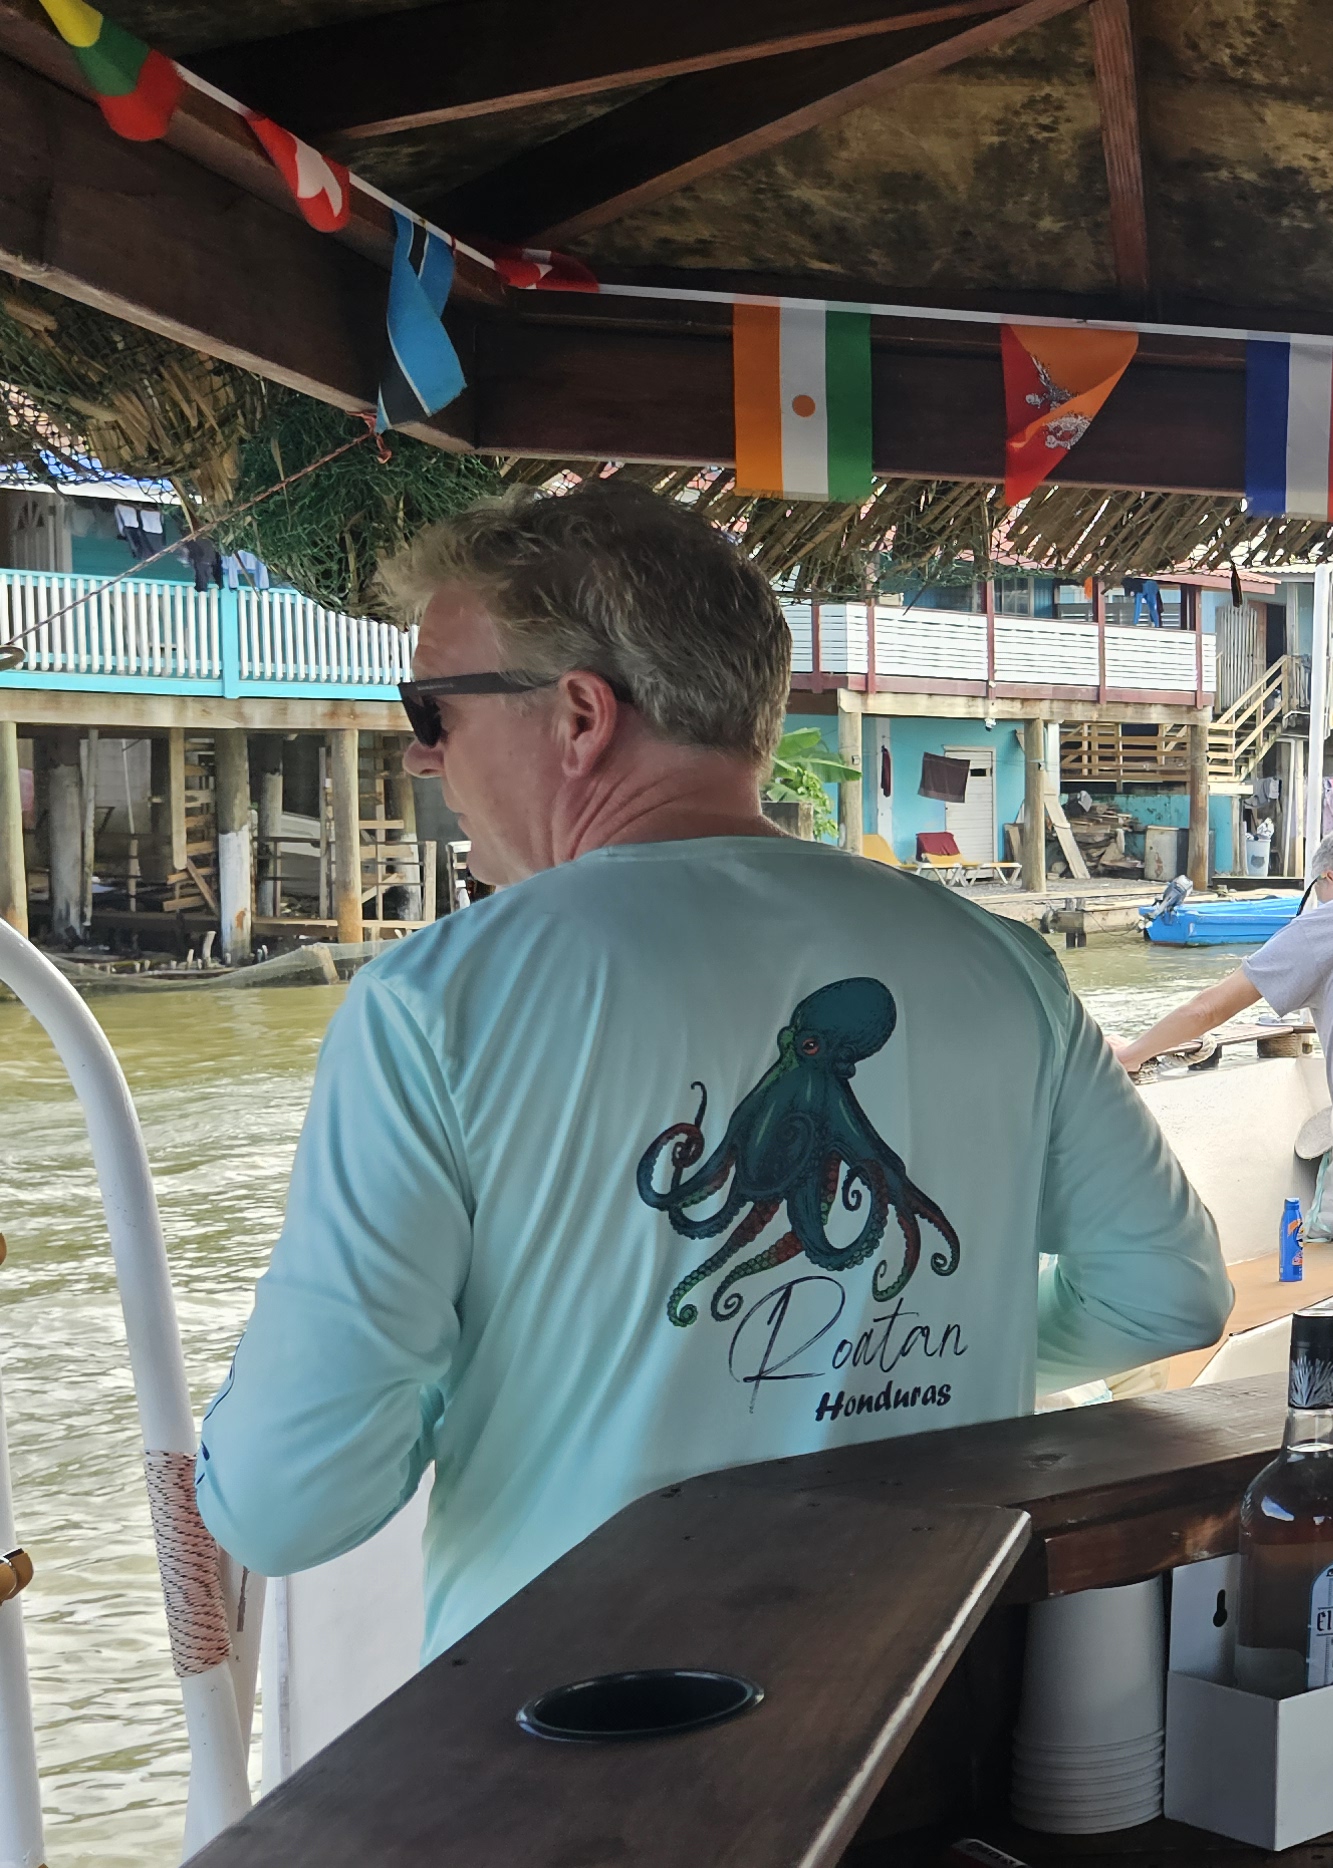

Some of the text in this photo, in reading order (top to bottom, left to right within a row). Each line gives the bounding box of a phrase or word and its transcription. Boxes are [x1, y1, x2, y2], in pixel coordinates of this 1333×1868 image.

[728, 1275, 969, 1414] Roatan
[815, 1380, 952, 1421] Honduras
[1316, 1609, 1332, 1632] El
